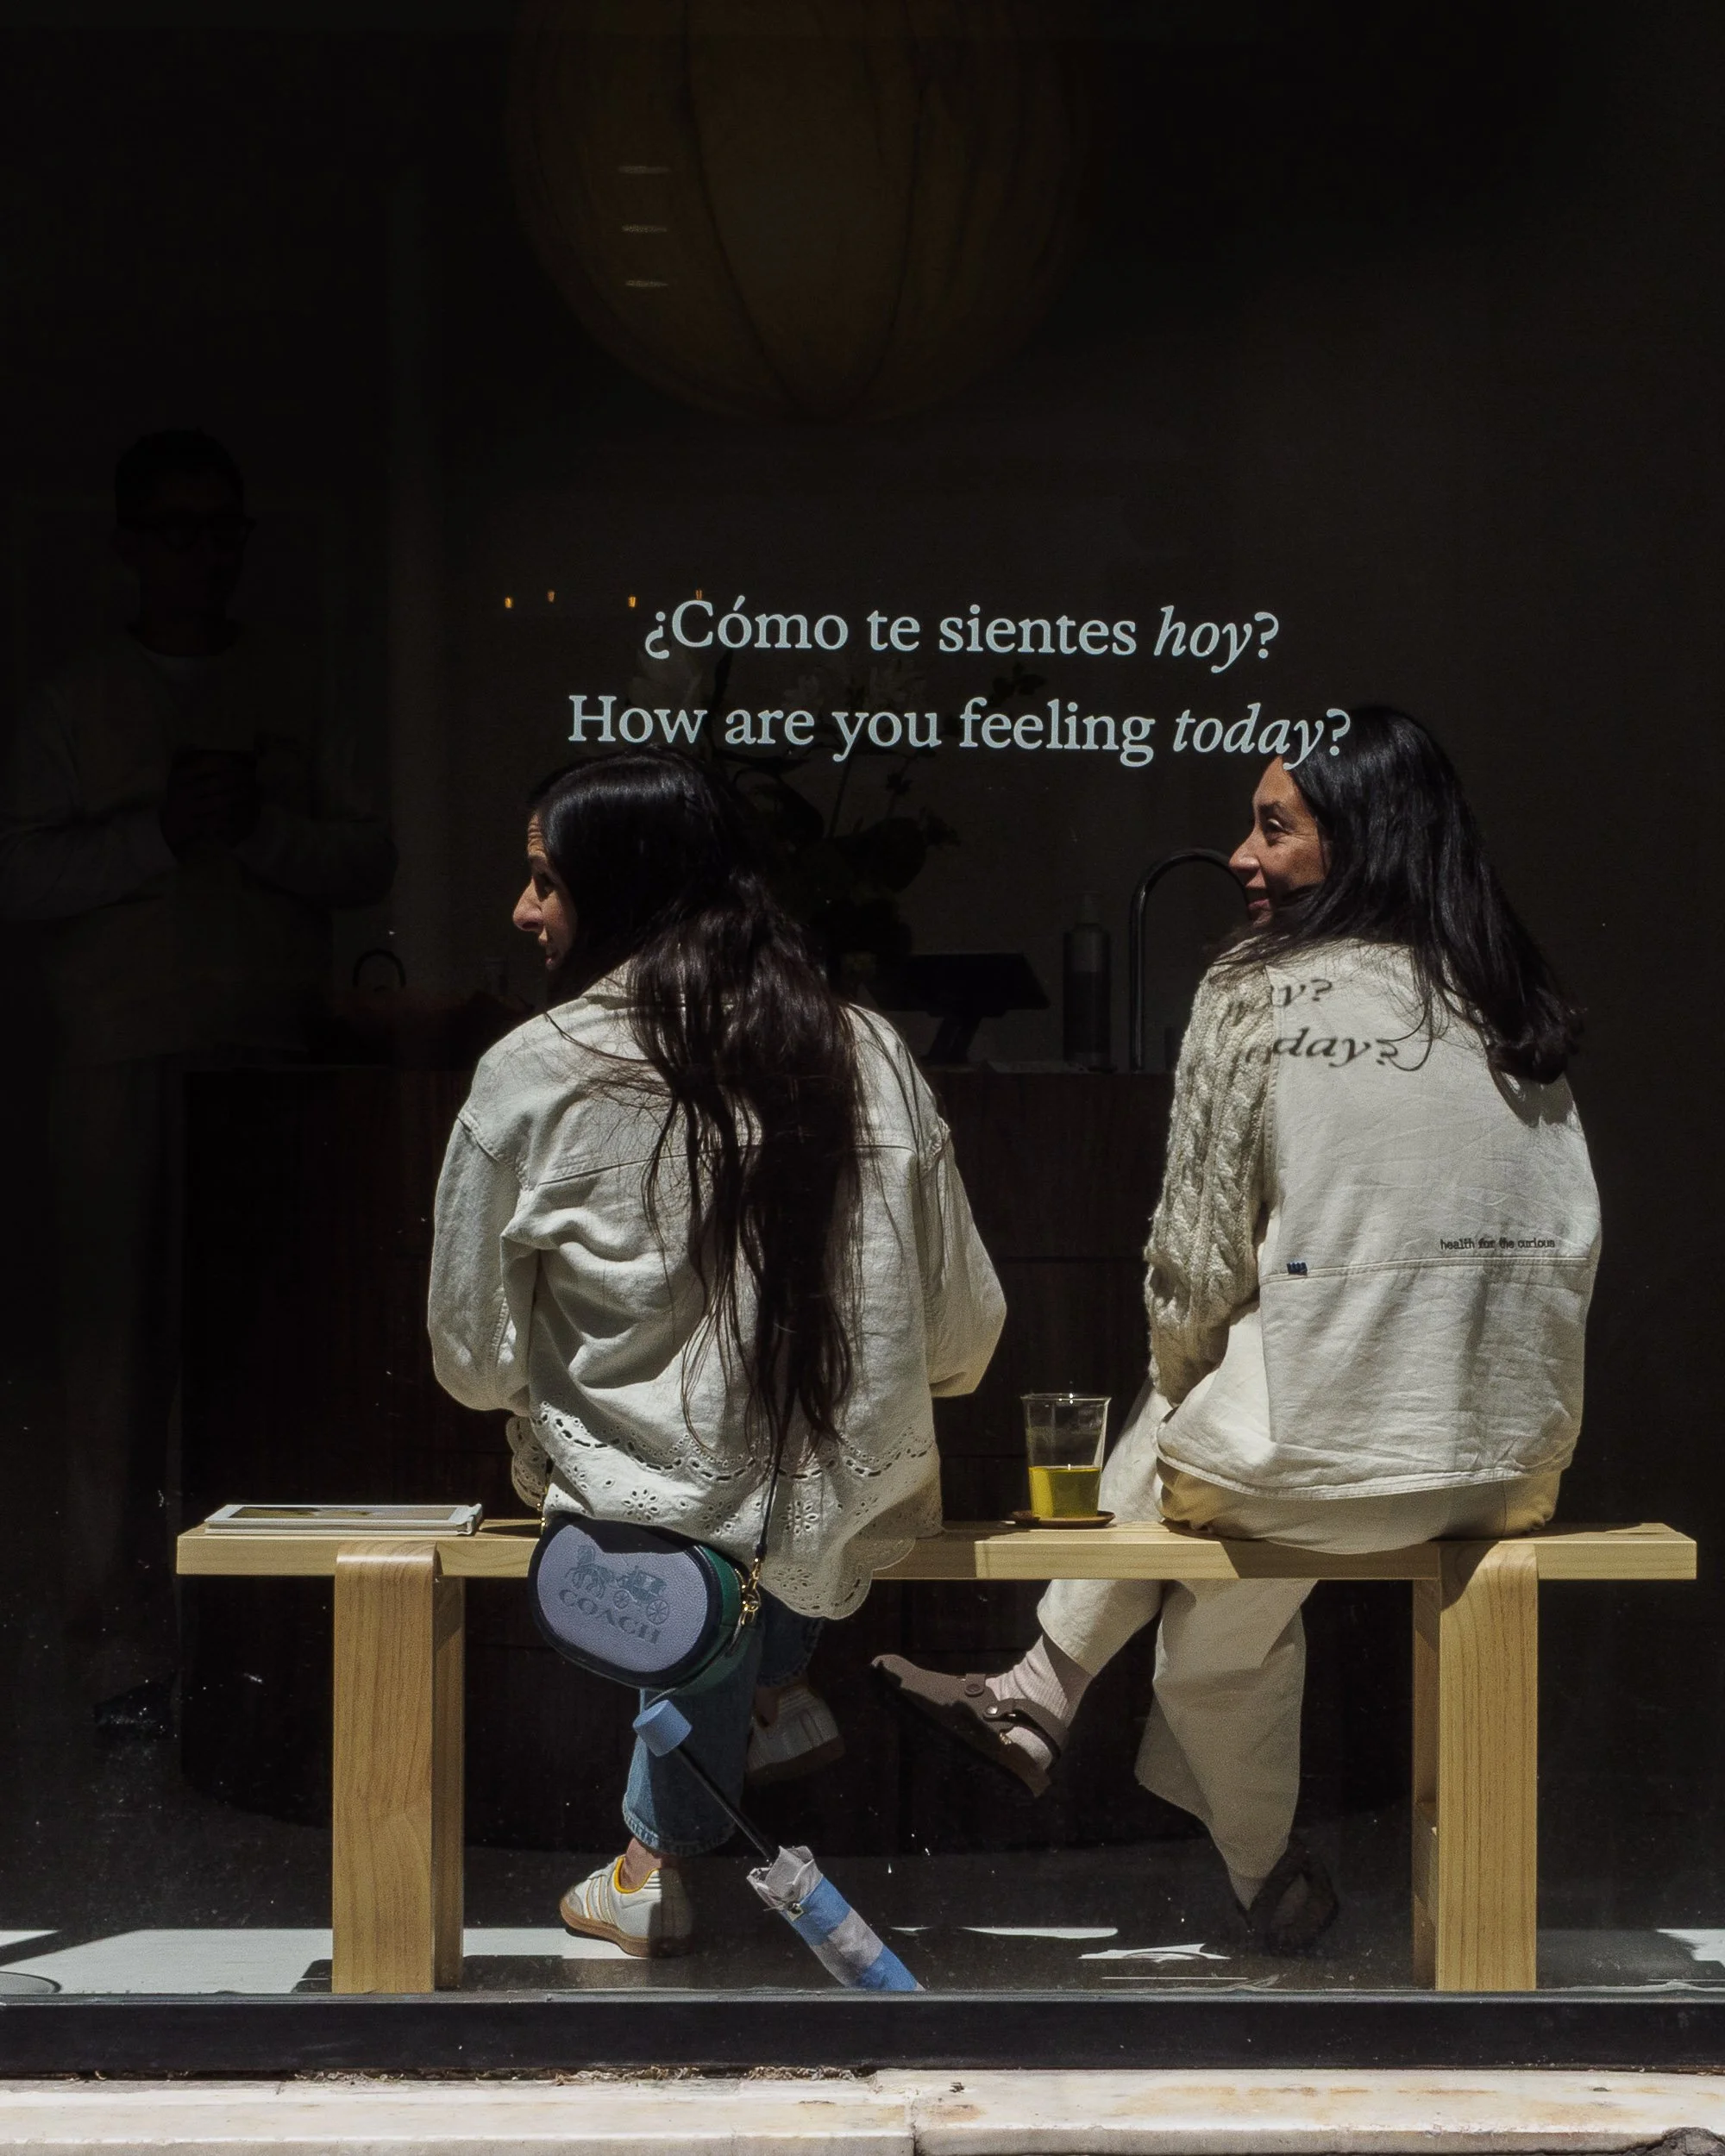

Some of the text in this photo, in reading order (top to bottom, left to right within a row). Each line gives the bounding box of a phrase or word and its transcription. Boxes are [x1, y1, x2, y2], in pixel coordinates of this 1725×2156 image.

[644, 594, 1279, 674] ¿Cómo te sientes hoy?
[568, 695, 1351, 772] How are you feeling today?
[1440, 1237, 1556, 1250] health for the curious
[558, 1589, 662, 1645] COACH
